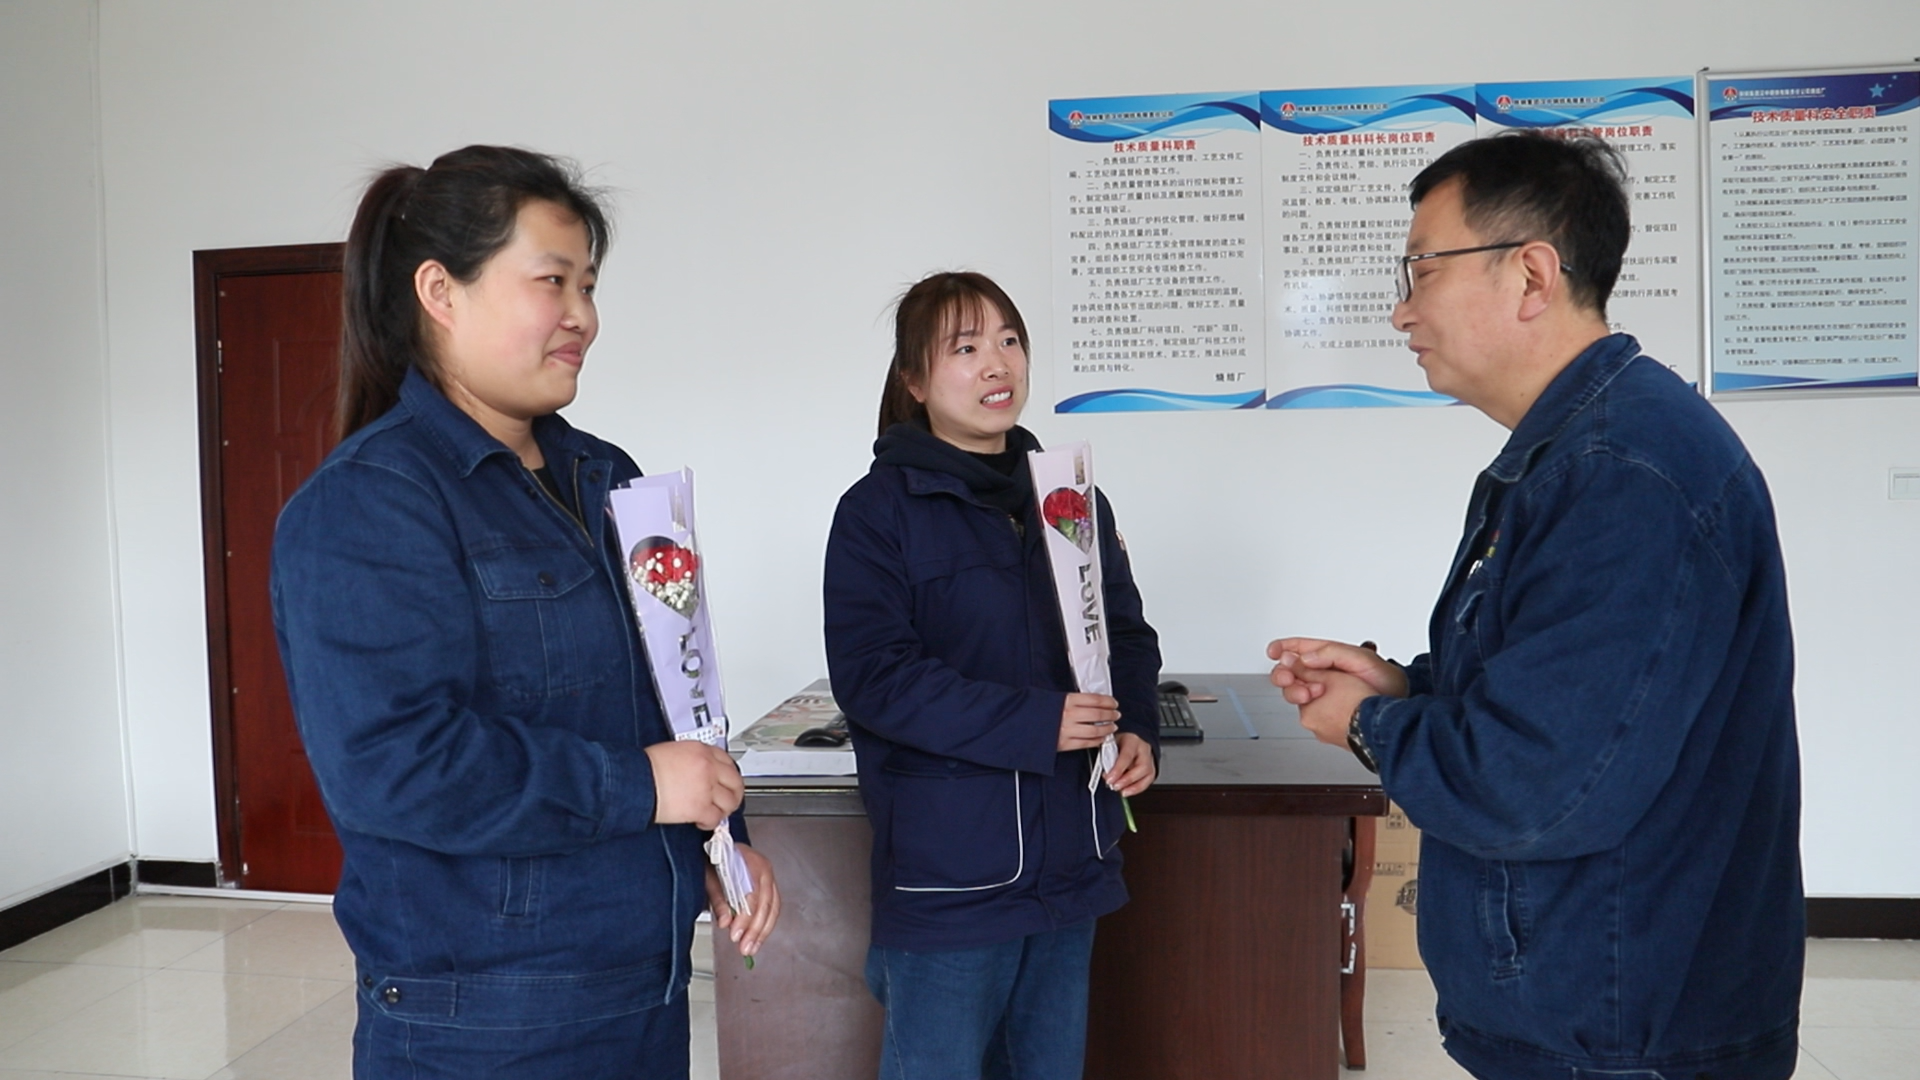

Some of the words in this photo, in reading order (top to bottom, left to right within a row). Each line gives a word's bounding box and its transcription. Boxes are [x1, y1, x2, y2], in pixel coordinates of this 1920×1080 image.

[1752, 106, 1876, 123] 技术质量科安全职责
[1115, 139, 1196, 153] 技术质量科职责
[1303, 131, 1435, 147] 技术质量科科长岗位职责
[1282, 209, 1311, 218] 的问题。
[1215, 372, 1246, 382] 烧结厂
[1078, 563, 1101, 644] LOVE
